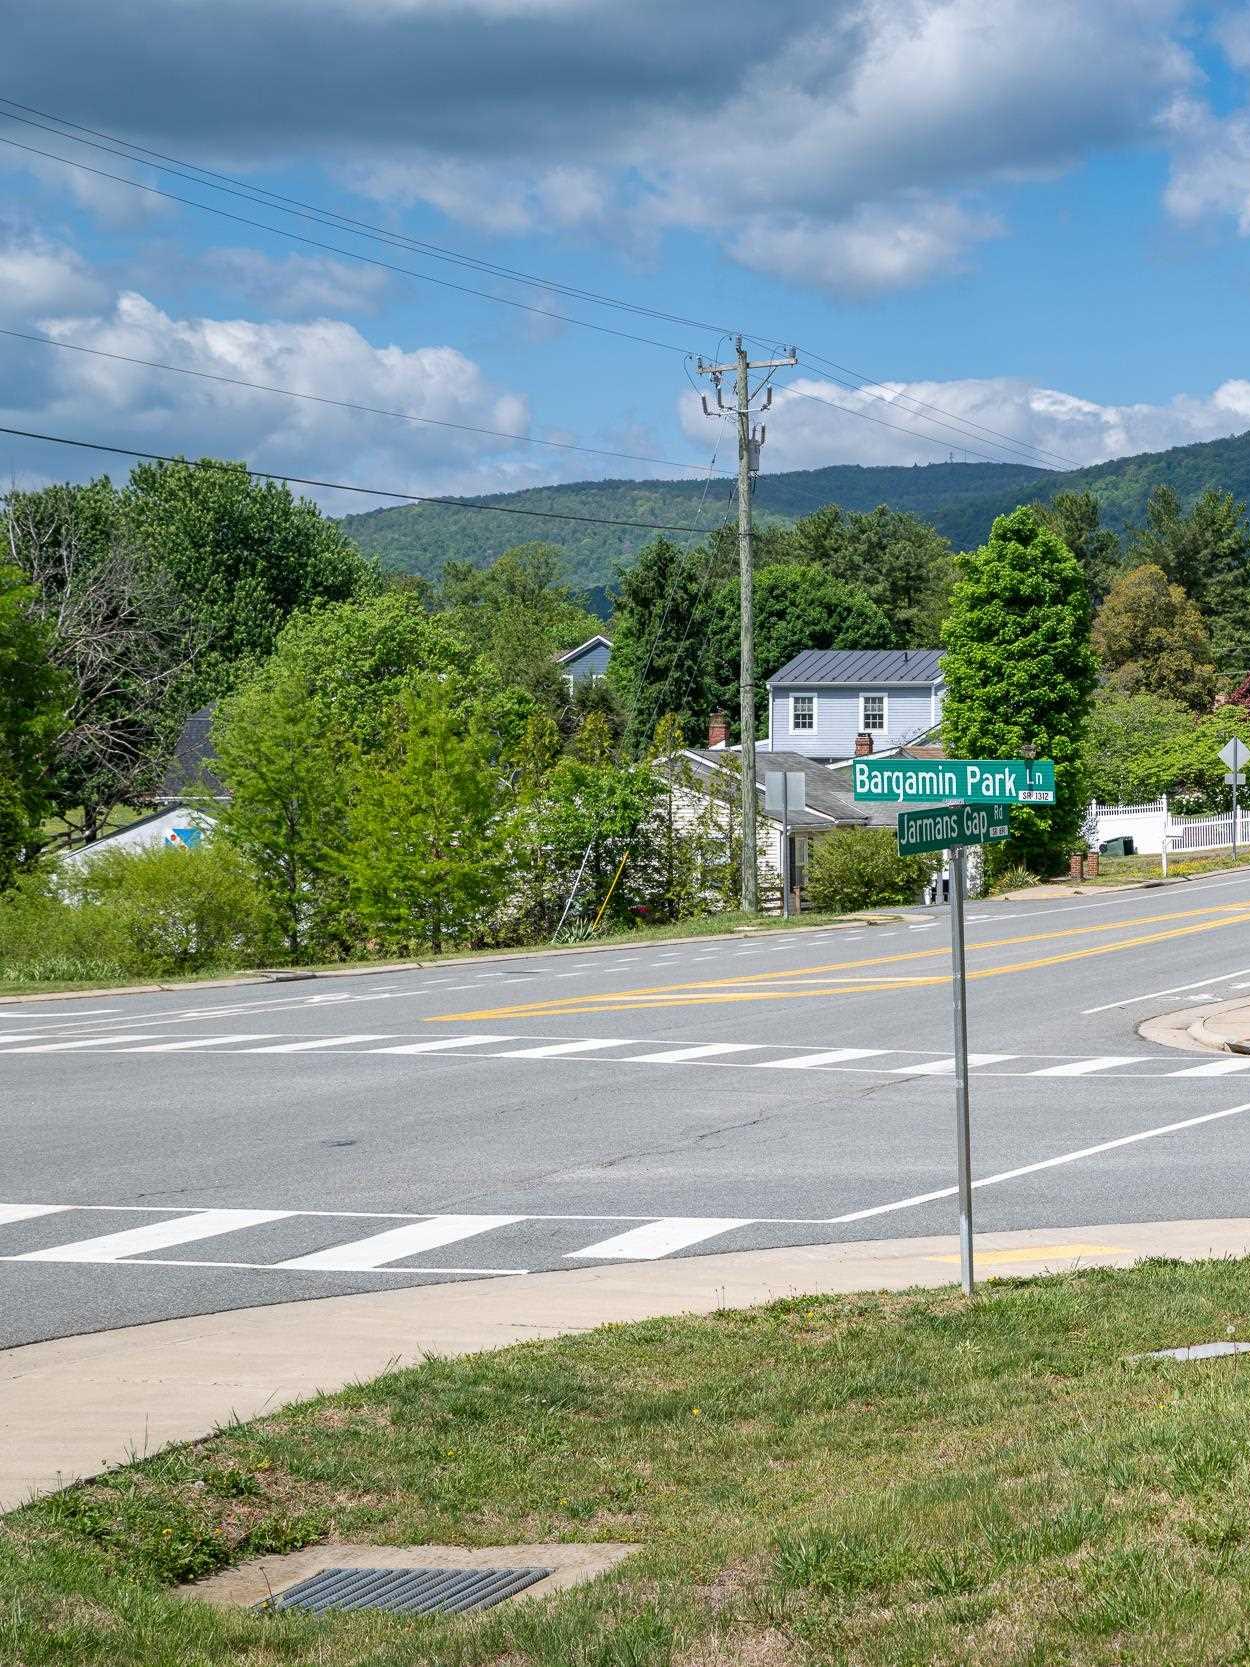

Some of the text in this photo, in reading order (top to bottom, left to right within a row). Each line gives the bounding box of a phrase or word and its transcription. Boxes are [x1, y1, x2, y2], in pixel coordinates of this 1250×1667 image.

[855, 763, 1043, 802] Bargamin Park Ln
[1022, 792, 1049, 800] SR 1312
[900, 804, 1003, 845] Jarmans Gap Rd
